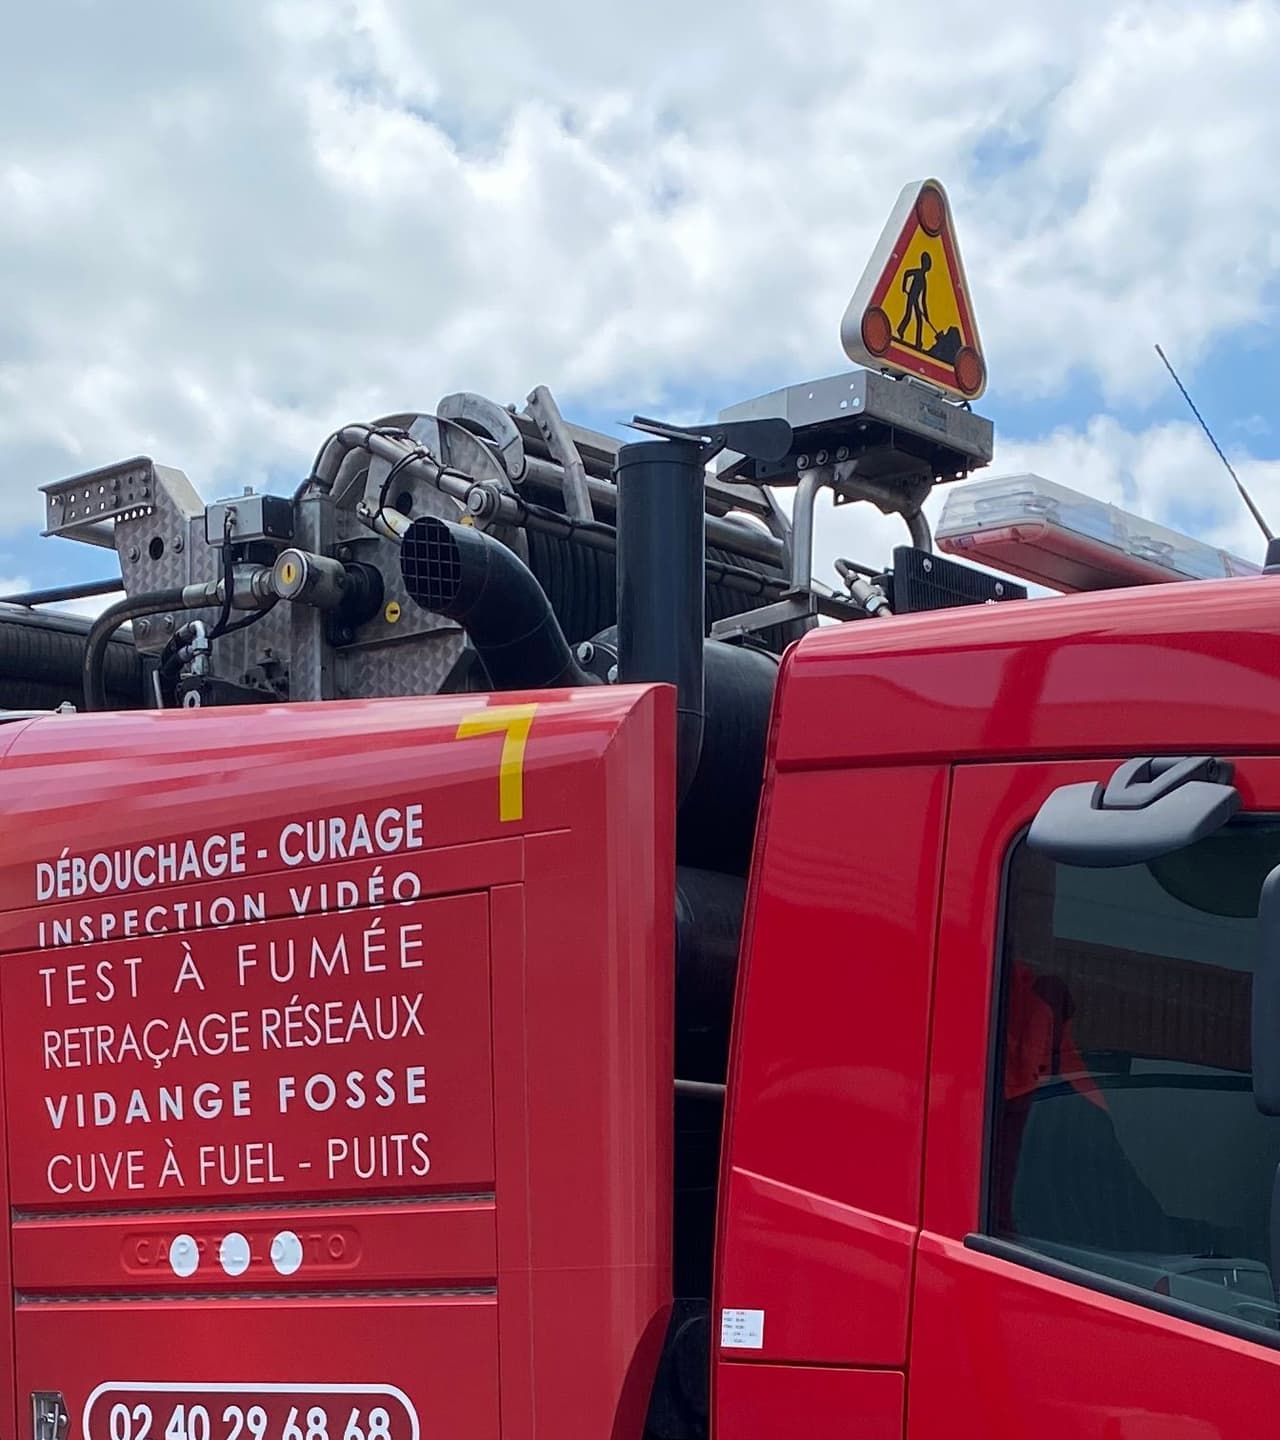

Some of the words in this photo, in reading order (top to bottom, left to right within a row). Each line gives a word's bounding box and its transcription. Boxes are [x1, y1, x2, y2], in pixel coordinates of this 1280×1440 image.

[456, 703, 538, 822] 7
[36, 831, 247, 901] DÉBOUCHAGE
[279, 804, 423, 867] CURAGE
[39, 892, 266, 951] INSPECTION
[289, 866, 421, 918] VIDÉO
[39, 957, 143, 1007] TEST
[173, 941, 205, 993] À
[238, 917, 424, 986] FUMÉE
[44, 1010, 250, 1070] RETRAÇAGE
[261, 993, 425, 1050] RÉSEAUX
[45, 1080, 252, 1130] VIDANGE
[278, 1066, 427, 1114] FOSSE
[47, 1150, 145, 1194] CUVE
[158, 1138, 184, 1188] À
[199, 1142, 285, 1186] FUEL
[327, 1132, 431, 1180] PUITS
